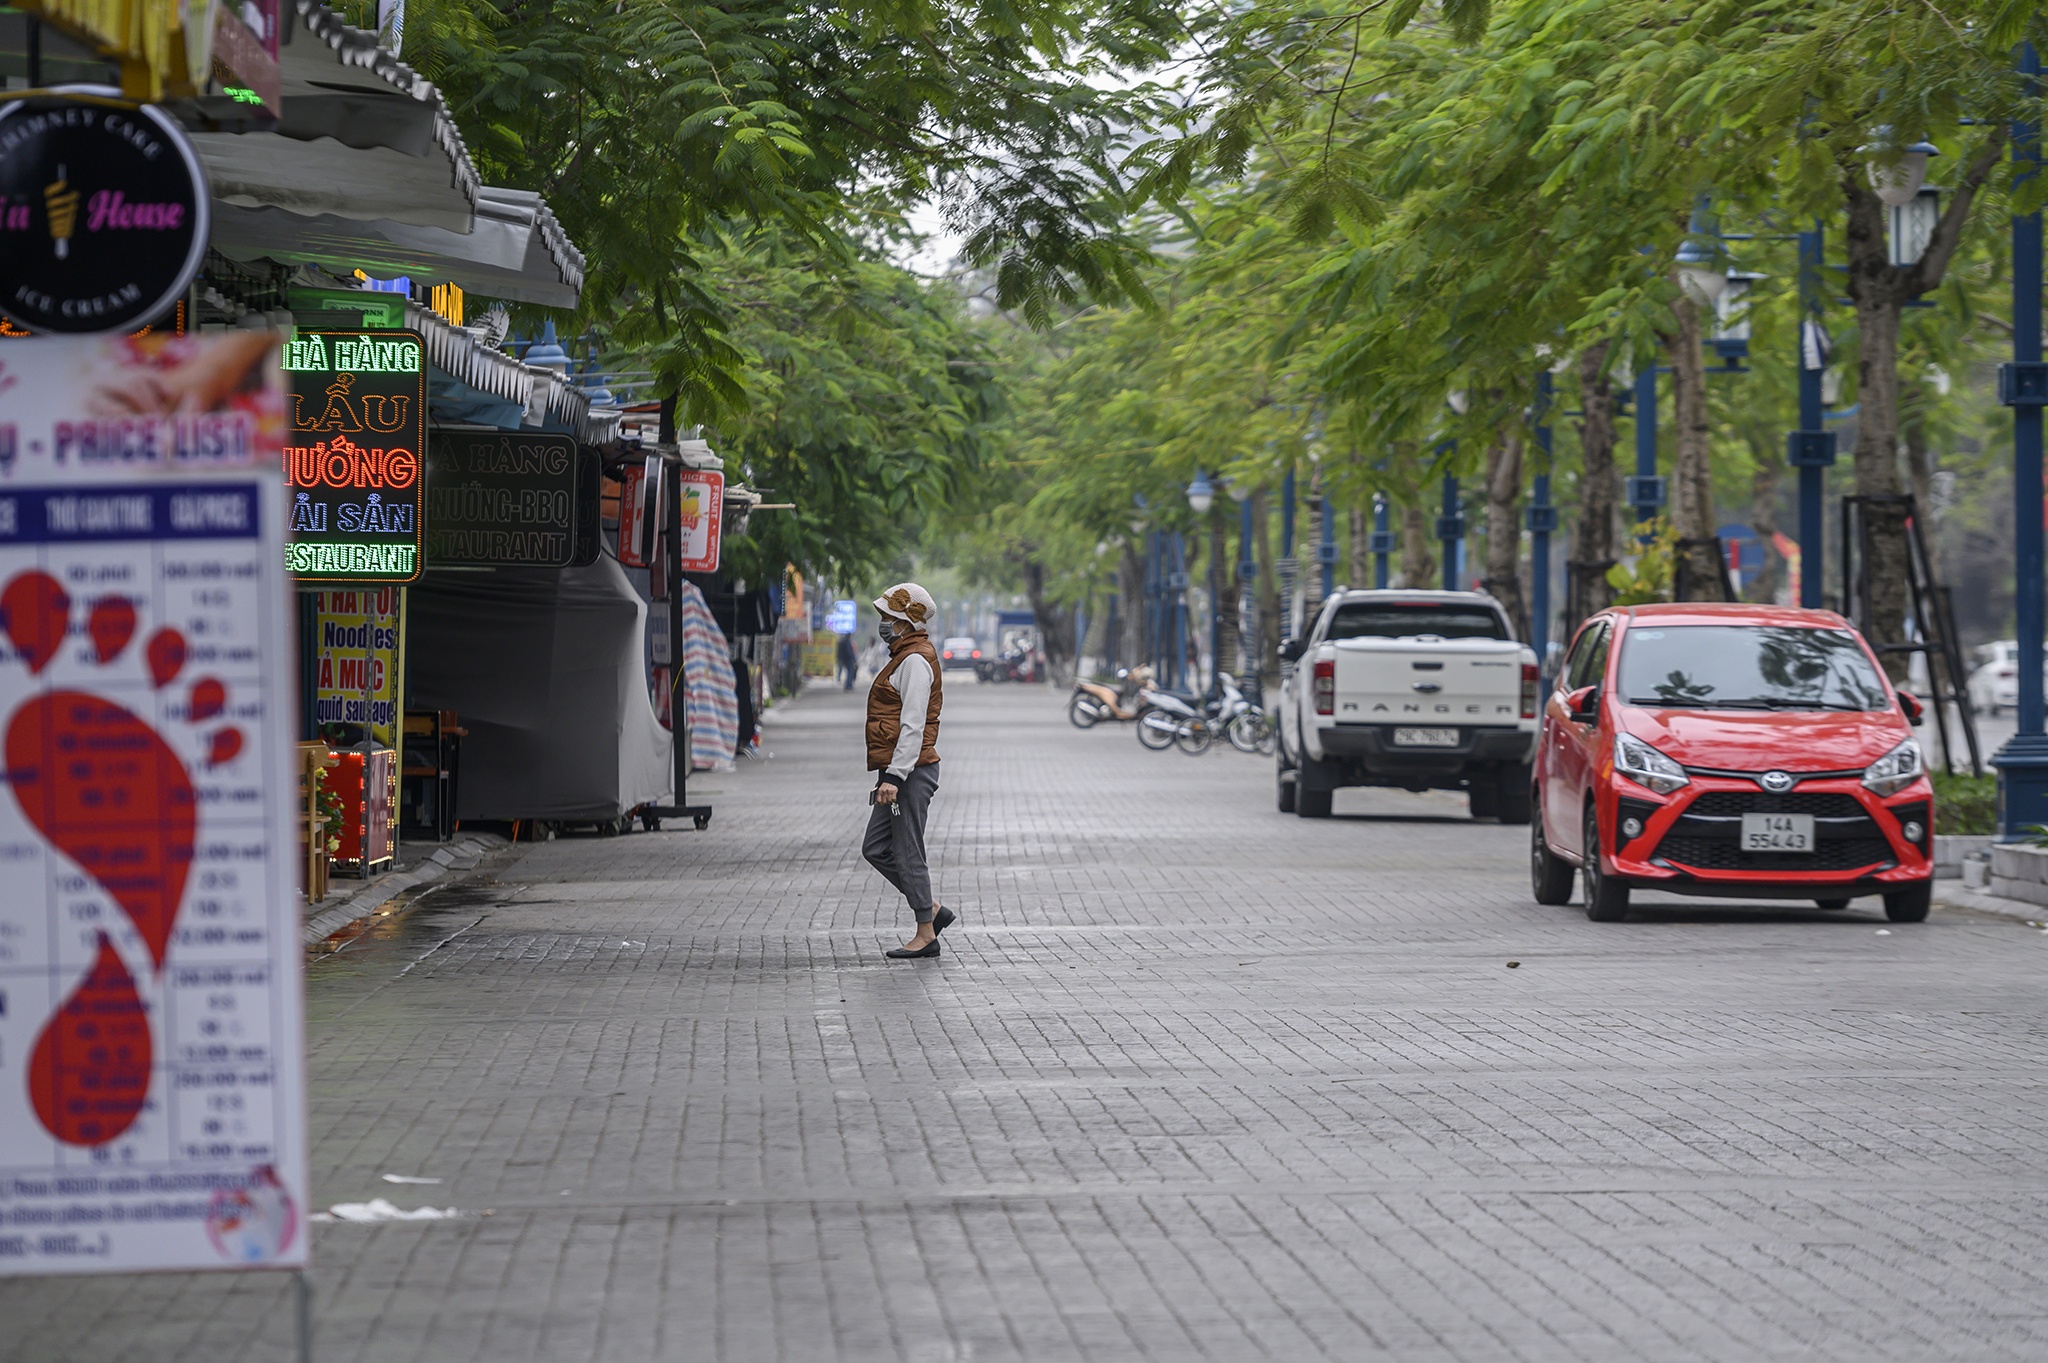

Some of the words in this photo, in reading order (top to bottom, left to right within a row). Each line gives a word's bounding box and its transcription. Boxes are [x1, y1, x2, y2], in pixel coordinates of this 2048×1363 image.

[0, 108, 97, 160] HIMNEY
[104, 113, 163, 161] CAKE
[87, 189, 186, 232] House
[15, 284, 53, 312] ICE
[61, 282, 141, 318] CREAM
[335, 335, 420, 372] HÀNG
[54, 420, 158, 465] PRICE
[175, 415, 247, 461] LIST
[469, 437, 569, 475] HÀNG
[287, 492, 327, 532] ẢI
[336, 493, 413, 532] SẢN
[710, 484, 720, 520] FRUIT
[325, 622, 393, 649] Noodes
[346, 700, 393, 726] sauage
[1343, 702, 1512, 713] RANGER
[1749, 833, 1806, 849] 554.43
[1765, 817, 1793, 832] 14A
